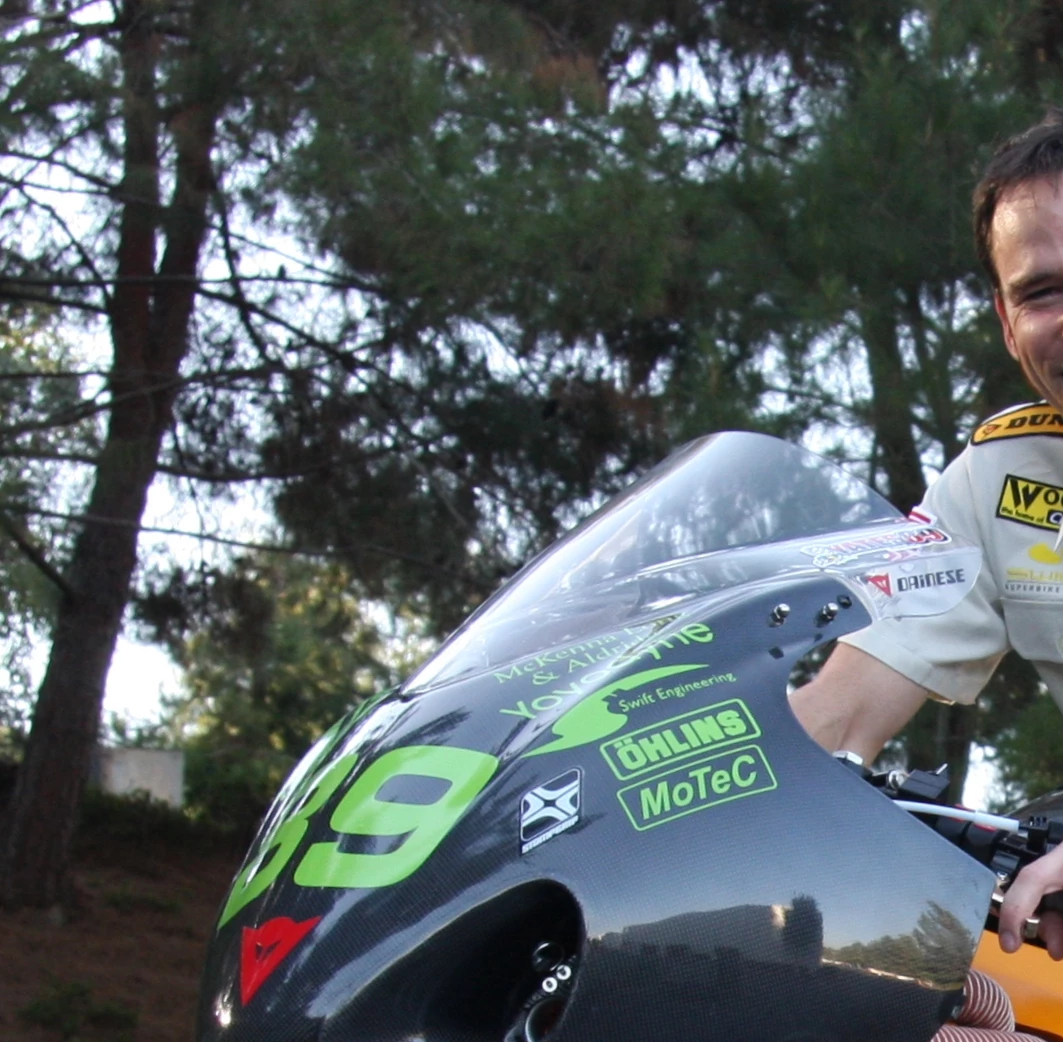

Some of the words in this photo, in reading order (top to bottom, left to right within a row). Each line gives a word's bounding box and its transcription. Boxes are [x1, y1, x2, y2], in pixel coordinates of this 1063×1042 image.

[618, 691, 656, 714] Swift
[656, 671, 737, 700] Engineering
[614, 709, 747, 771] ÖHLINS
[639, 754, 757, 820] MoTeC
